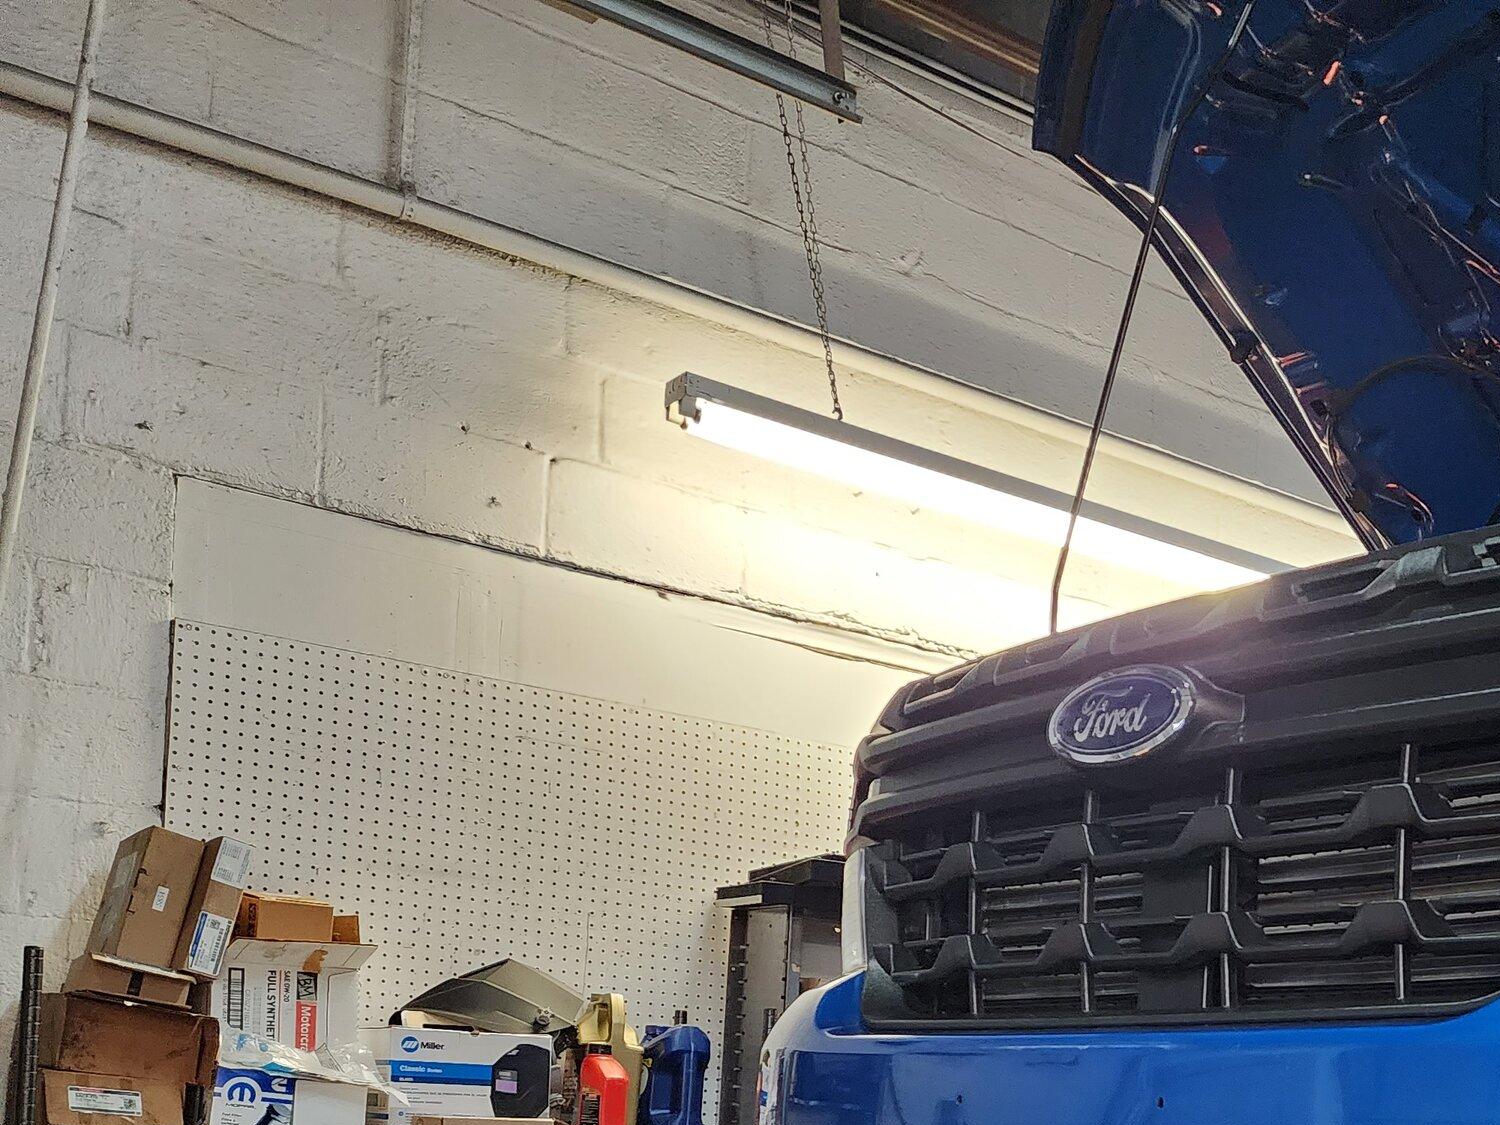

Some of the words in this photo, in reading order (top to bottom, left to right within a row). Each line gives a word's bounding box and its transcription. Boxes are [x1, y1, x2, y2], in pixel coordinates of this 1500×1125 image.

[1073, 685, 1152, 742] Ford
[267, 970, 277, 994] FULL
[266, 995, 276, 1041] SYNTHET
[300, 1006, 311, 1051] Motorcra
[420, 1041, 445, 1050] Miller
